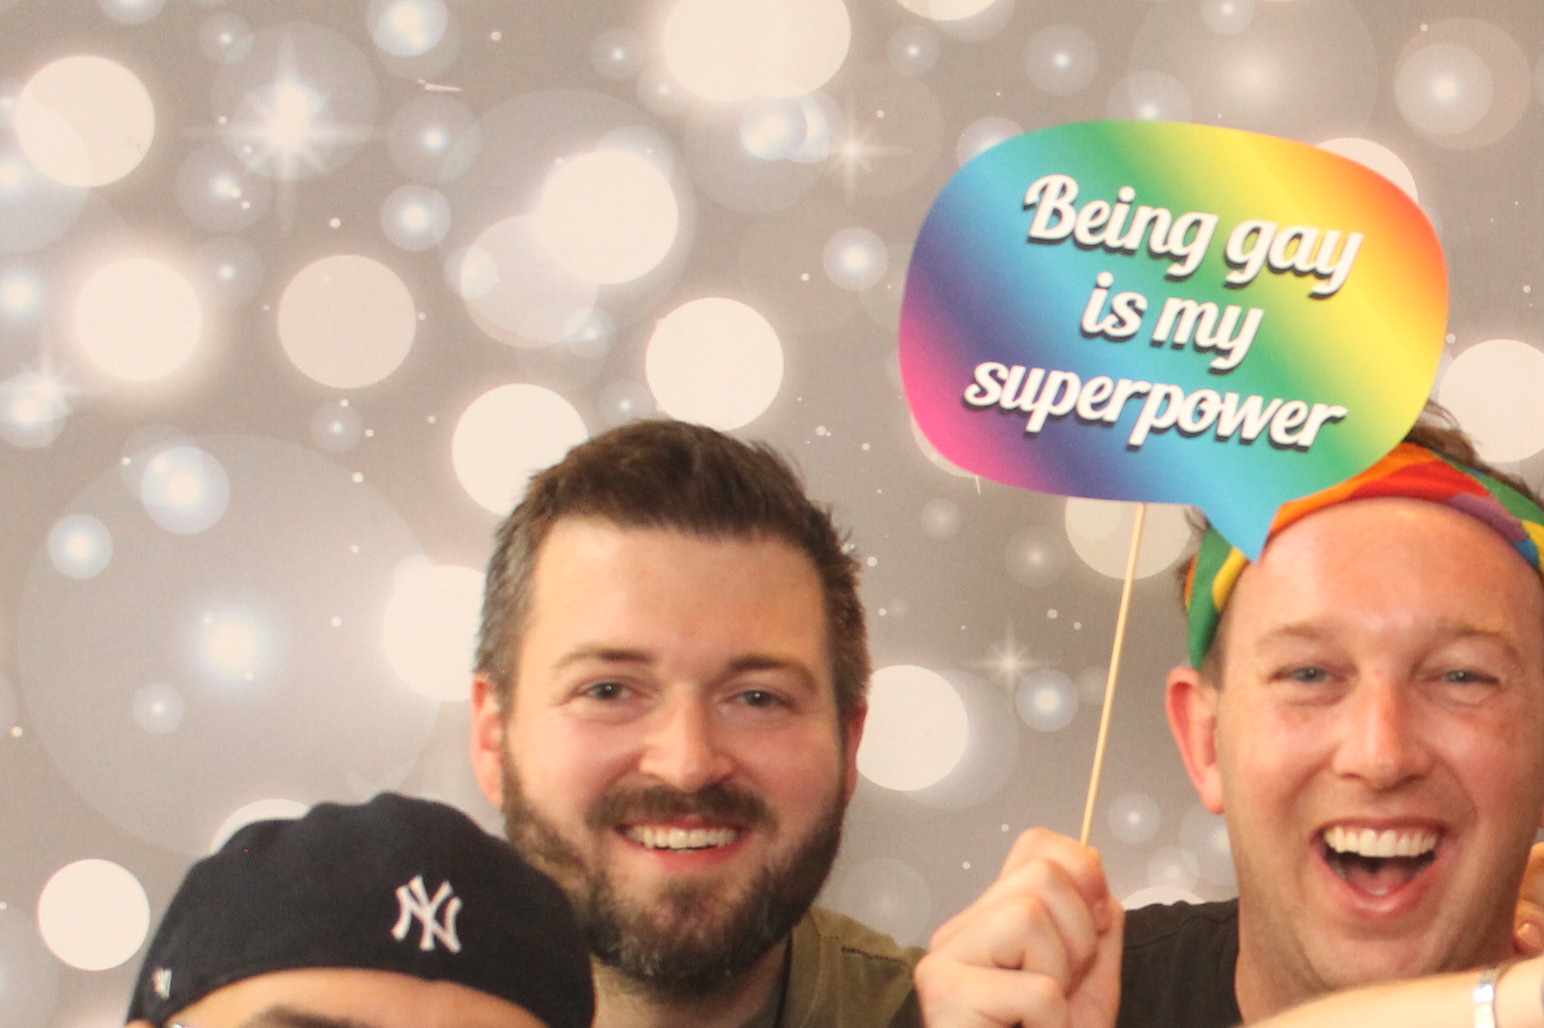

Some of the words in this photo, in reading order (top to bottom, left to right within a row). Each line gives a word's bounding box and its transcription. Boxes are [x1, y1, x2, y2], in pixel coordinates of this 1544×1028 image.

[1023, 173, 1219, 280] Being
[1224, 218, 1364, 297] gay
[1080, 271, 1148, 341] is
[1150, 296, 1264, 372] my
[962, 361, 1348, 452] superpower
[391, 875, 462, 954] NY
